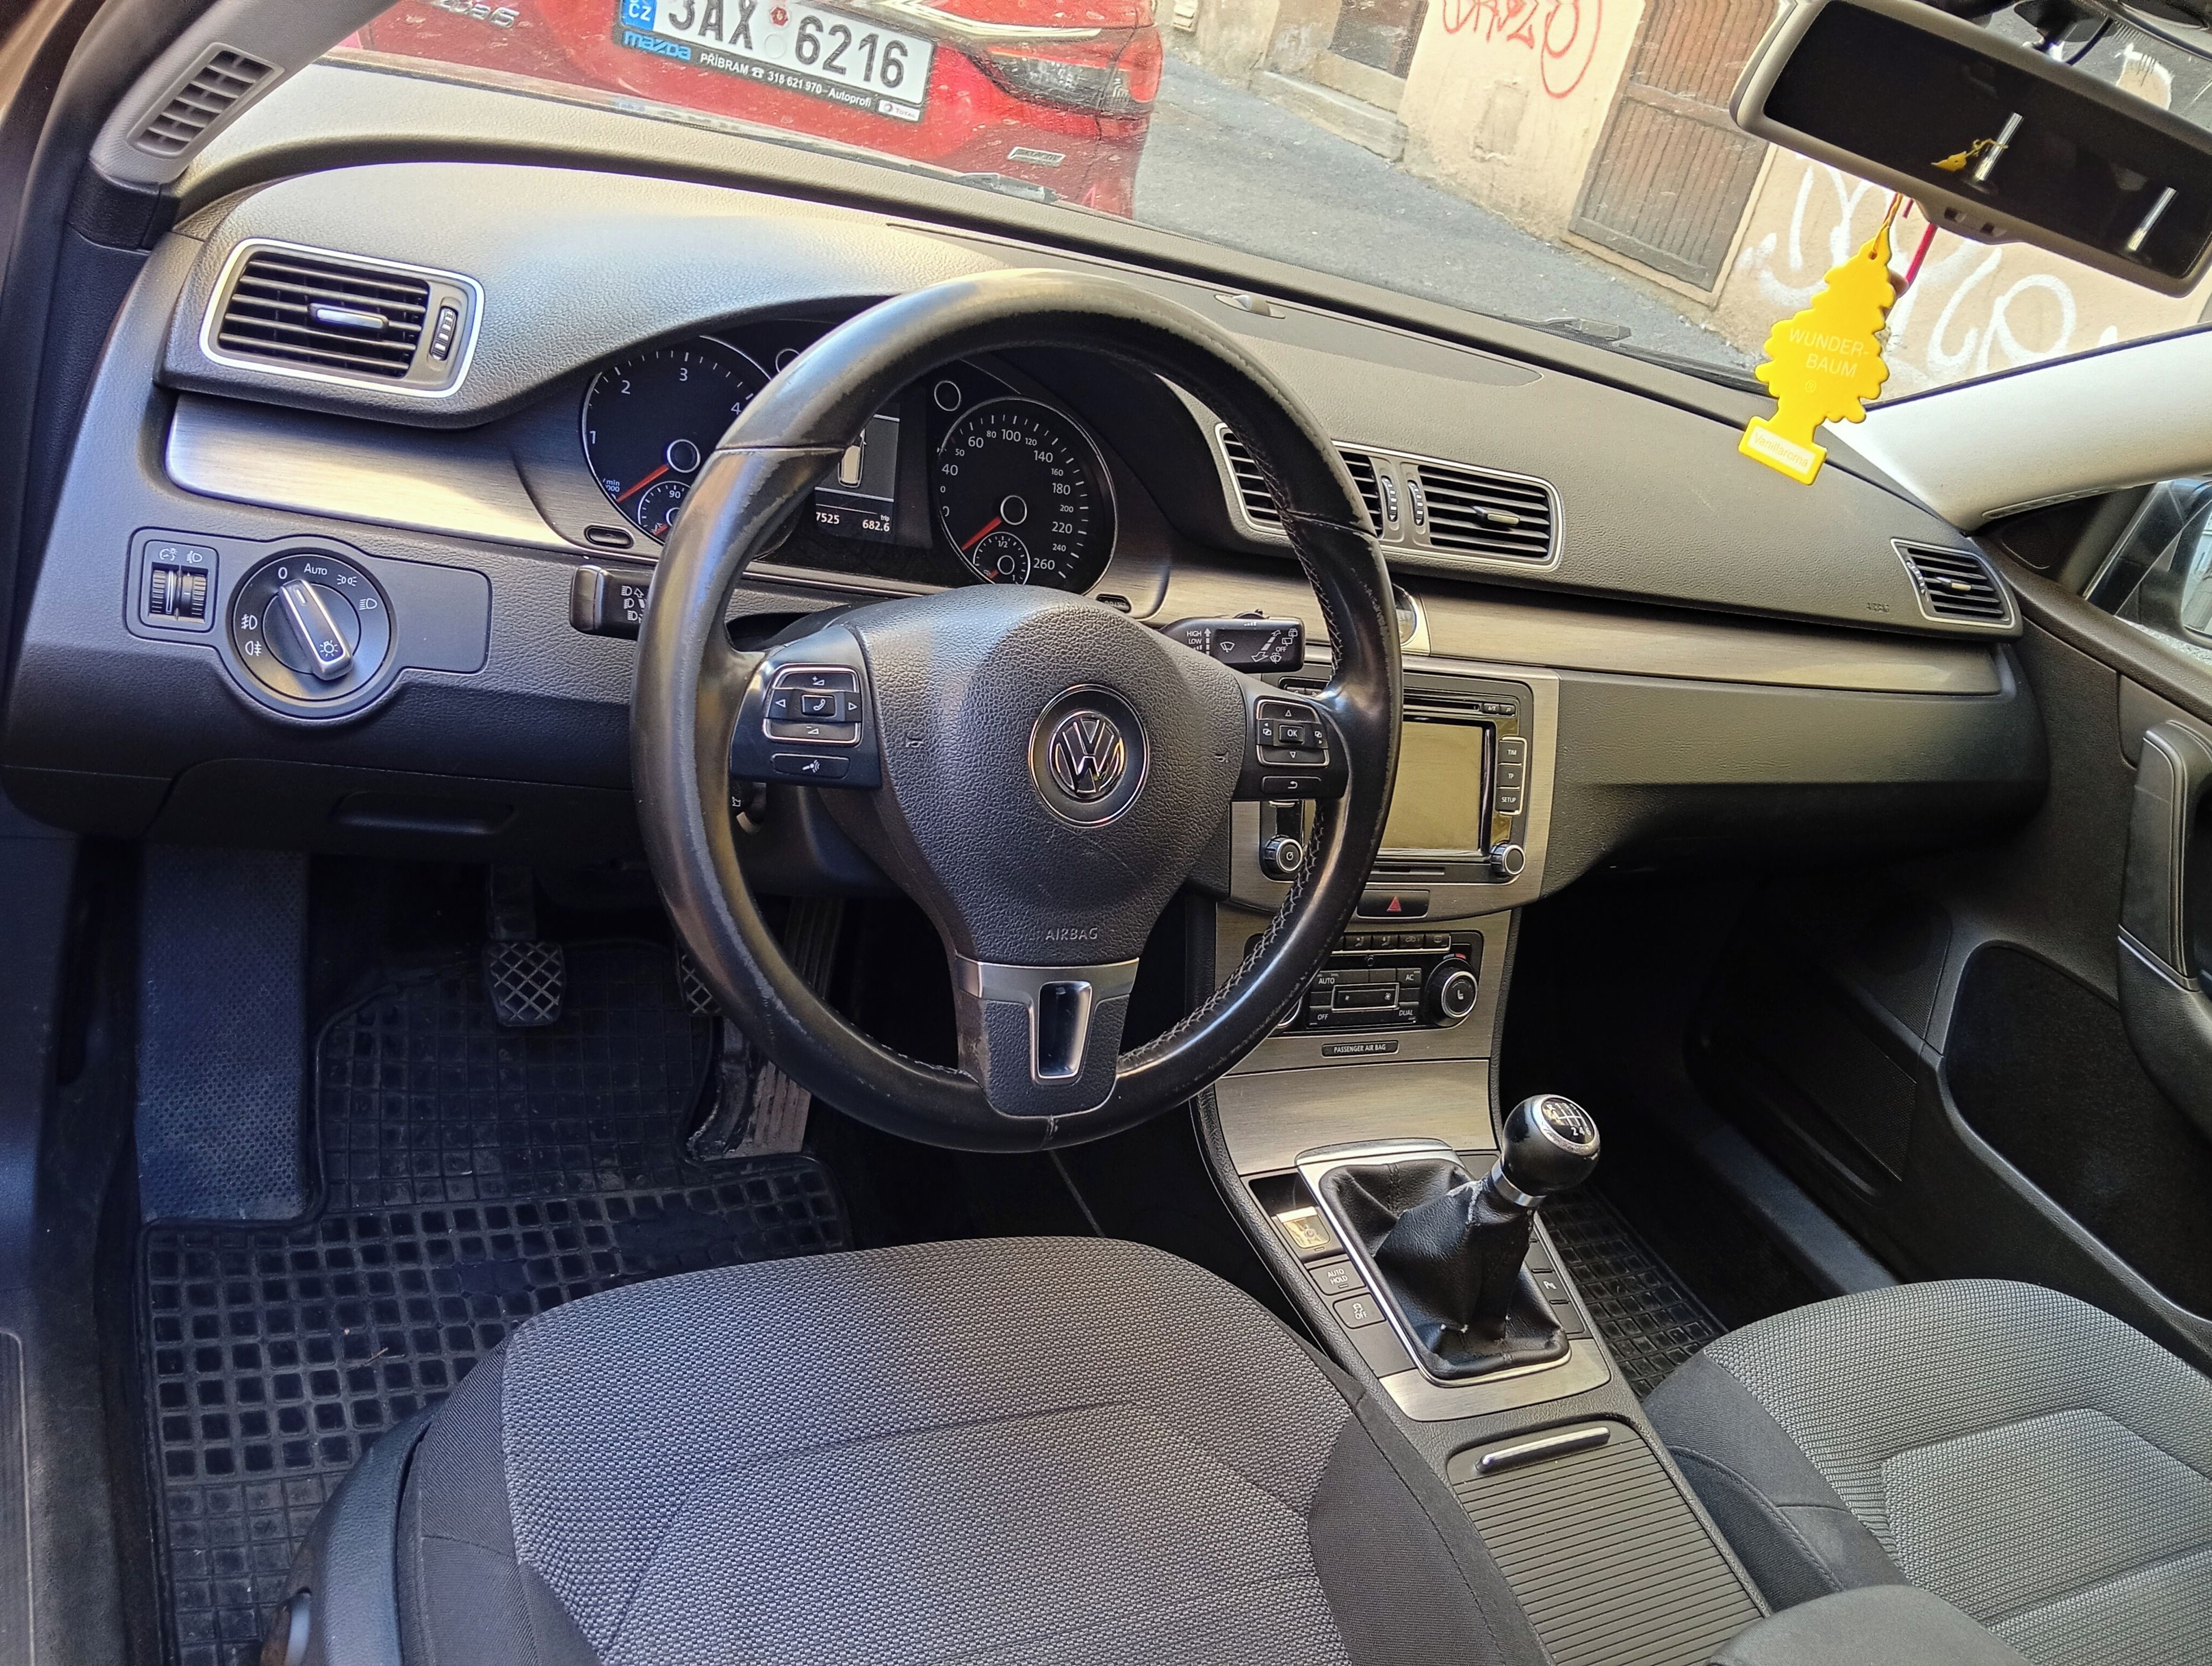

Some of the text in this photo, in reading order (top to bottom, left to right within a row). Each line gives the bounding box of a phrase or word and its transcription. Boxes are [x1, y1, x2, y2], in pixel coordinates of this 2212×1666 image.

[628, 3, 651, 21] CZ
[668, 0, 908, 88] 3AX 6216
[623, 31, 691, 60] mazda
[767, 71, 786, 85] 318
[787, 75, 803, 89] 621
[805, 80, 822, 94] 970
[827, 88, 872, 107] Autoprofi
[1790, 327, 1869, 357] WUNDER-
[1805, 353, 1857, 378] BAUM
[679, 368, 688, 381] 3
[621, 380, 631, 395] 2
[731, 402, 741, 415] 4
[590, 431, 596, 444] 1
[986, 430, 996, 438] 80
[1001, 429, 1021, 442] 100
[968, 436, 983, 448] 60
[1025, 437, 1037, 446] 120
[1754, 433, 1809, 467] Vanillaroma
[1033, 450, 1053, 463] 140
[942, 464, 958, 476] 40
[1051, 468, 1064, 477] 160
[669, 490, 681, 498] 90
[1052, 483, 1071, 495] 180
[1060, 504, 1073, 512] 200
[815, 512, 840, 524] 7525
[863, 520, 890, 532] 682.6
[1052, 521, 1072, 534] 220
[1052, 543, 1066, 552] 240
[1033, 558, 1055, 571] 260
[1287, 729, 1298, 738] OK
[1045, 927, 1098, 941] AIRBAG
[1334, 1045, 1364, 1053] PASSENGER
[1571, 1127, 1578, 1136] 2
[1579, 1126, 1585, 1135] 4
[1327, 1268, 1345, 1278] AUTO
[1330, 1275, 1348, 1284] HOLD
[1355, 1311, 1367, 1319] OFF
